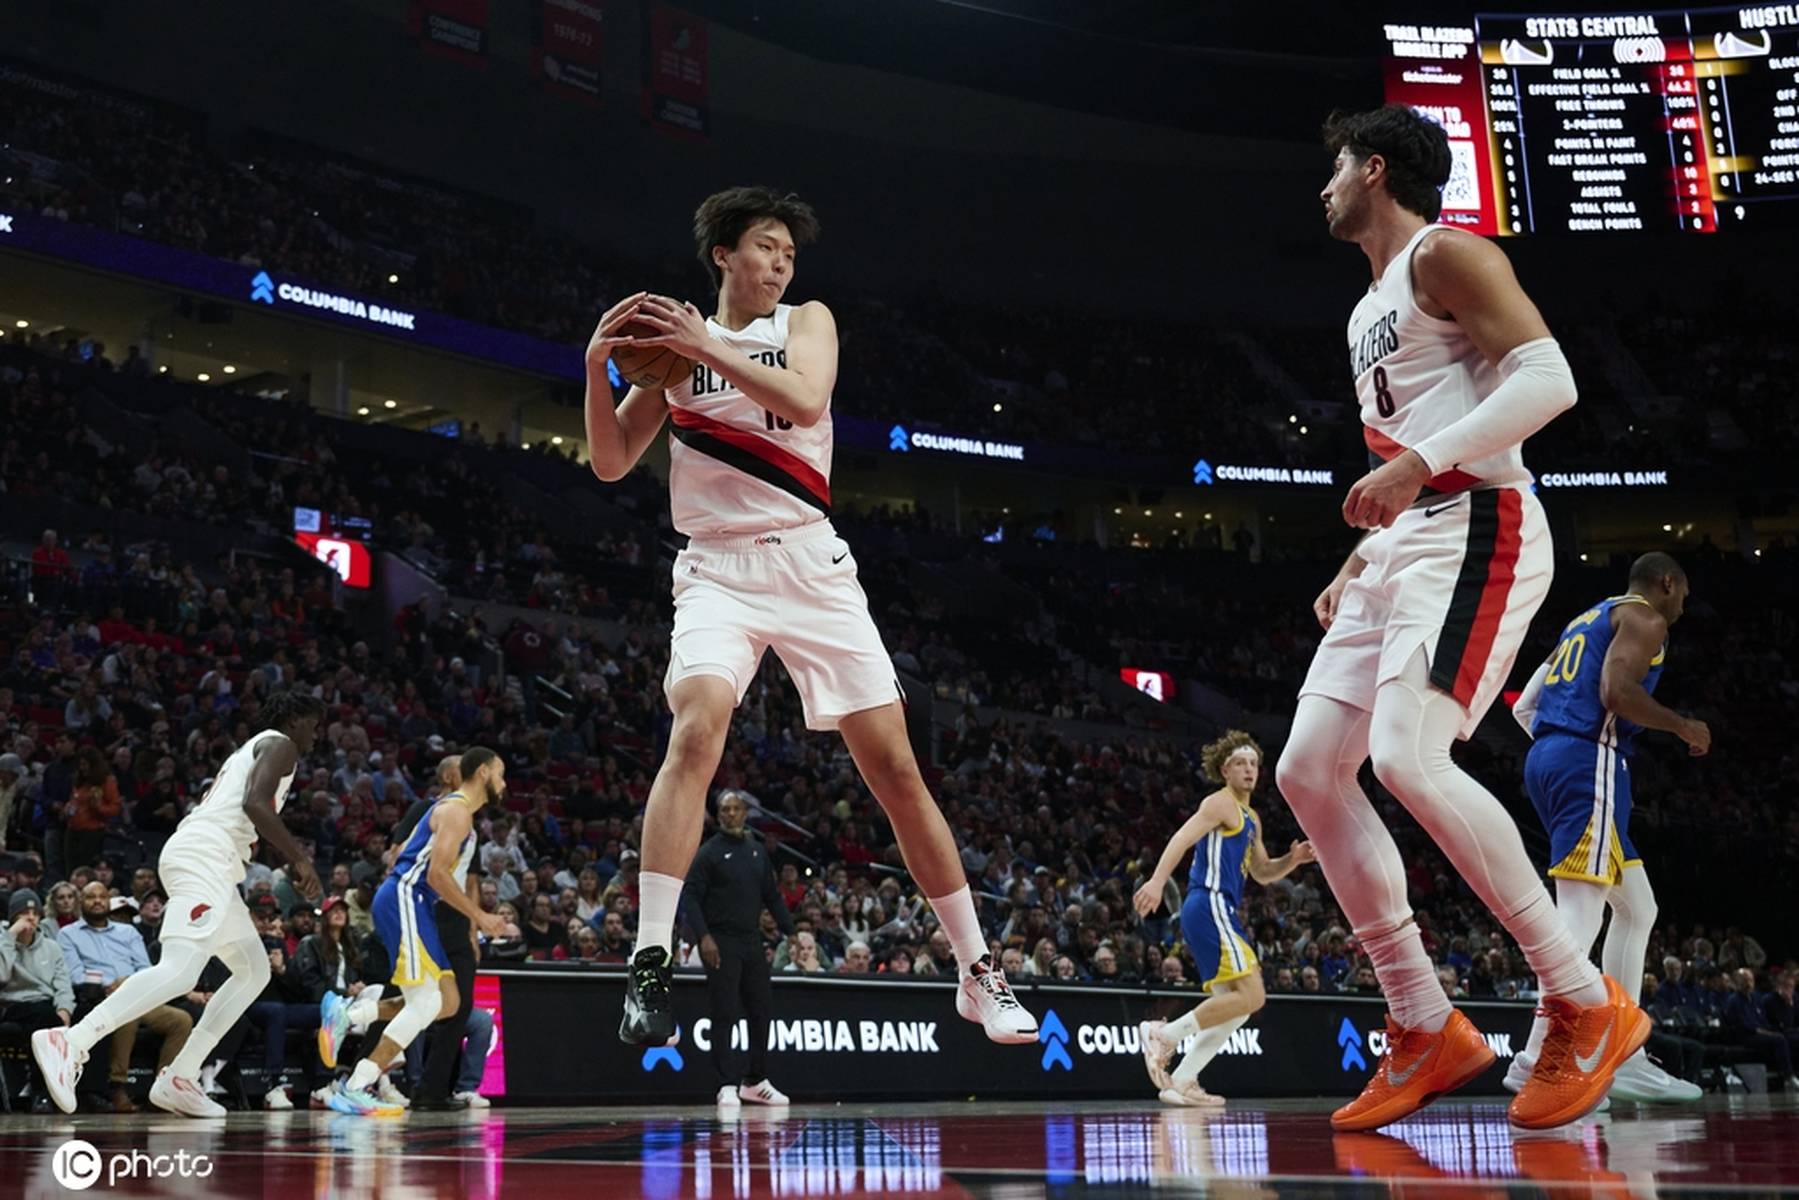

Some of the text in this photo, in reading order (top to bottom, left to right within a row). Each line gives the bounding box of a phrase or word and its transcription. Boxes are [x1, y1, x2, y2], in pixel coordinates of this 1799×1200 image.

[1526, 16, 1659, 37] STATS CENTRAL
[1553, 68, 1581, 79] FIELD
[1583, 68, 1609, 79] GOAL
[1528, 84, 1580, 95] EFFECTIVE
[1612, 83, 1639, 94] GOAL
[1556, 100, 1582, 111] FREE
[1504, 138, 1512, 149] 4
[1555, 138, 1591, 149] POINTS
[1606, 137, 1635, 148] PAINT
[1682, 135, 1691, 146] 4
[1505, 154, 1513, 166] 0
[1548, 153, 1646, 165] FAST BREAK POINTS
[1684, 151, 1692, 162] 0
[1572, 170, 1626, 181] REBOUNDS
[1581, 186, 1622, 197] ASSISTS
[1570, 202, 1635, 213] TOTAL FOULS
[1512, 221, 1521, 232] 0
[1569, 218, 1642, 230] BENCH POINTS
[1693, 217, 1702, 229] 0
[278, 283, 415, 330] COLUMBIA BANK
[1373, 365, 1396, 419] 8
[911, 432, 1024, 460] COLUMBIA BANK
[1216, 465, 1333, 485] COLUMBIA BANK
[1540, 471, 1667, 487] COLUMBIA BANK
[1544, 633, 1586, 685] 20
[859, 1020, 939, 1053] BANK
